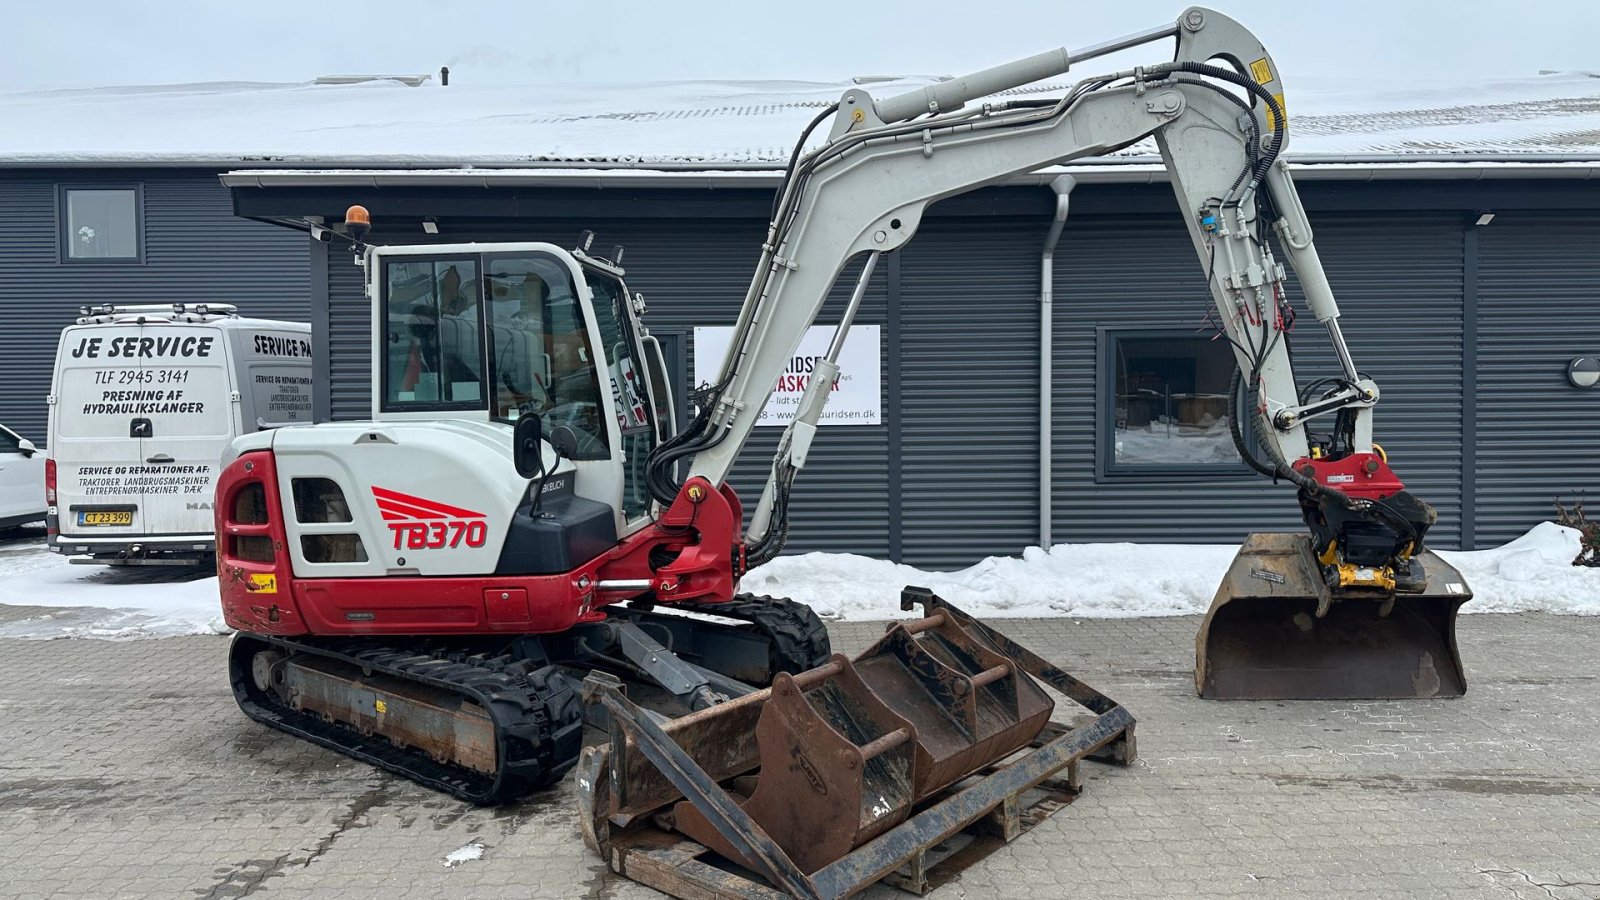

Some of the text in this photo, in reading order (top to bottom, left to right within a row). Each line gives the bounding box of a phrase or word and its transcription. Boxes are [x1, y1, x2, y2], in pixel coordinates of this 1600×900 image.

[72, 337, 214, 358] JE SERVICE
[254, 335, 298, 357] SERVICE
[95, 370, 188, 384] TLF 2945 3141
[102, 390, 183, 402] PRESNING AF
[776, 397, 789, 405] lidt
[83, 402, 204, 414] HYDRAULIKSLANGER
[79, 465, 210, 475] SERVICE OG REPARATIONER AF:
[79, 476, 209, 487] TRAKTORER LANDBRUGSMASKINER
[85, 485, 203, 496] ENTREPRENØRMASKINER DÆK
[85, 512, 130, 523] CT 23 399
[387, 521, 488, 550] TB370
